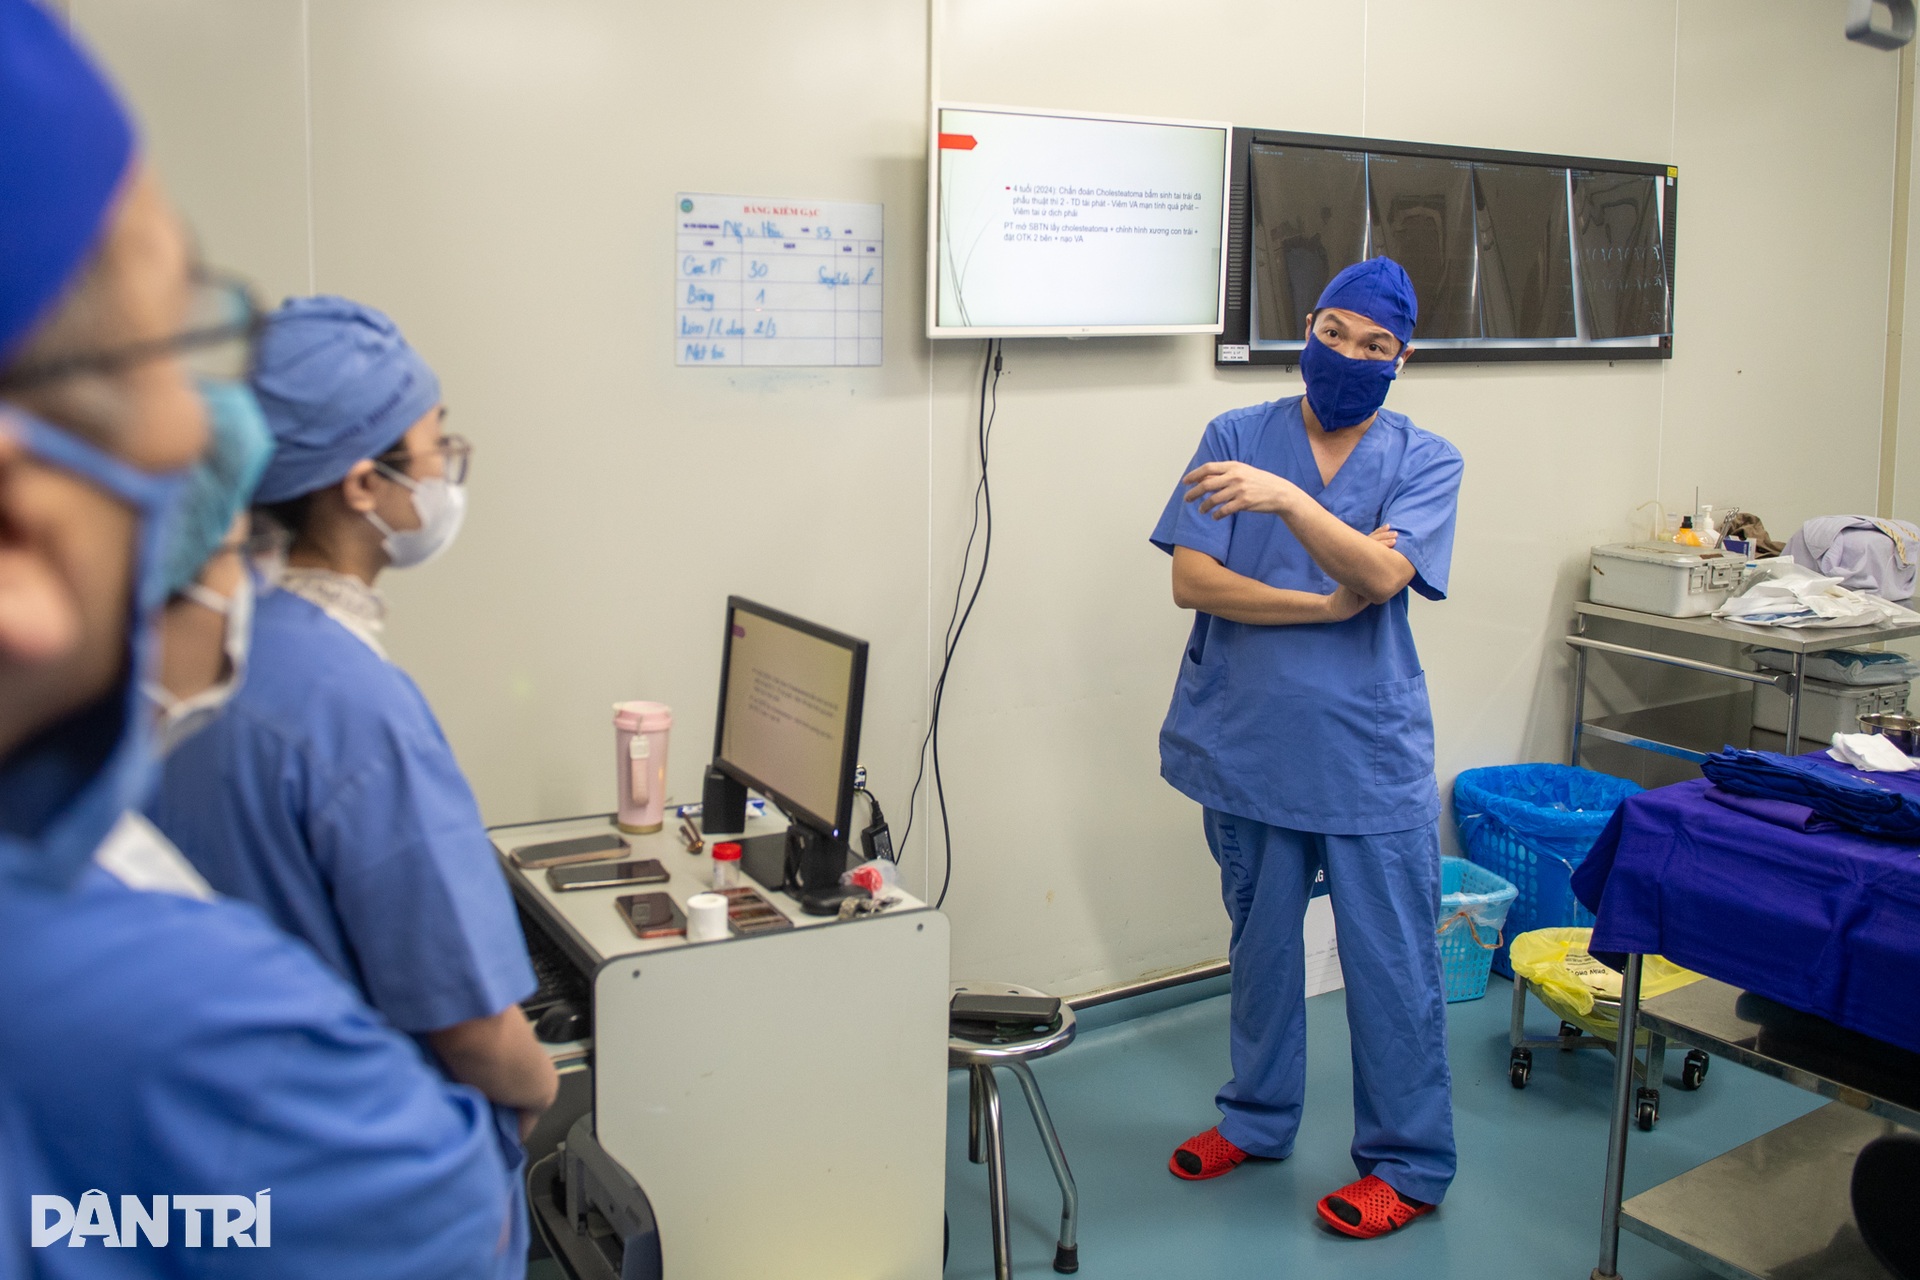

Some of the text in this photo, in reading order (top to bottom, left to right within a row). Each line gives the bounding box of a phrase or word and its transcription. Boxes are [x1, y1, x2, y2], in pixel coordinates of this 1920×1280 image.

[1019, 183, 1032, 193] tuổi
[1078, 187, 1095, 195] đoán
[1096, 188, 1143, 198] Cholesteatoma
[1182, 192, 1193, 200] trái
[1032, 197, 1048, 205] thuật
[1060, 198, 1065, 206] 2
[1071, 198, 1080, 206] TD
[1091, 199, 1106, 208] phát
[1111, 200, 1127, 208] Viêm
[1180, 203, 1193, 211] phát
[1048, 209, 1062, 217] dịch
[1061, 224, 1108, 233] cholesteatoma
[1134, 226, 1148, 234] hình
[1149, 228, 1169, 236] xương
[1016, 233, 1032, 241] OTK
[1033, 234, 1038, 242] 2
[1040, 234, 1052, 242] bên
[748, 260, 769, 278] 30
[756, 289, 765, 304] 1
